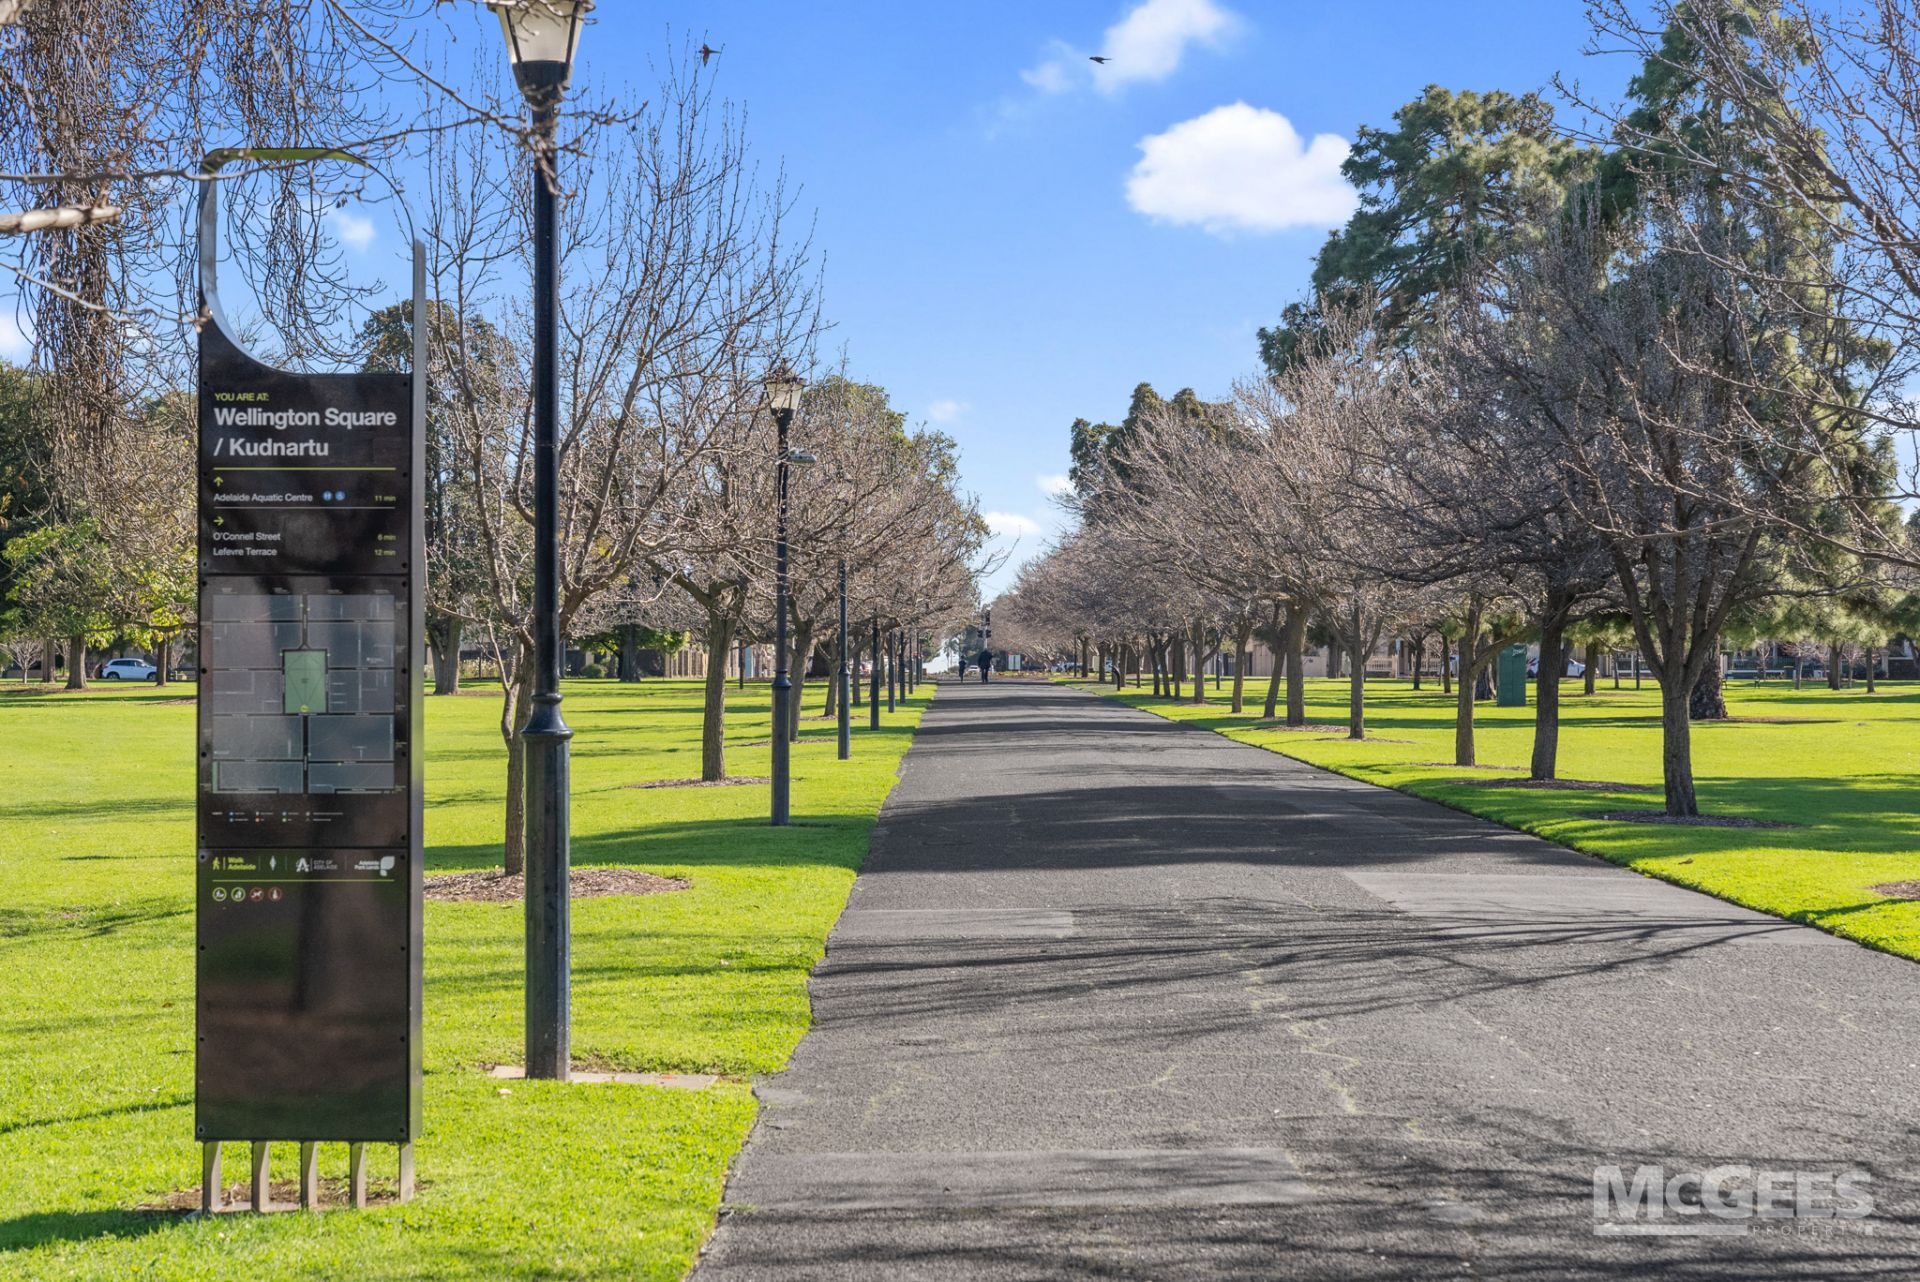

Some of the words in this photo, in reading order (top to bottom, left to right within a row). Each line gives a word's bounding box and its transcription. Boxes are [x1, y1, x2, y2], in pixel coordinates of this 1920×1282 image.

[214, 392, 236, 402] YOU
[236, 392, 255, 402] ARE
[214, 407, 320, 430] Wellington
[324, 407, 397, 430] Square
[213, 437, 224, 456] /
[229, 438, 329, 457] Kudnartu
[213, 492, 251, 502] Adelaide
[251, 492, 284, 503] Aquatic
[284, 492, 314, 502] Centre
[374, 494, 382, 502] 11
[383, 494, 397, 502] min
[212, 532, 255, 541] O'Connell
[255, 532, 281, 541] Street
[383, 533, 397, 541] min
[212, 547, 245, 556] Lefevre
[245, 547, 278, 556] Terrace
[374, 548, 383, 556] 12
[383, 548, 397, 556] min
[228, 863, 257, 871] Adelaide
